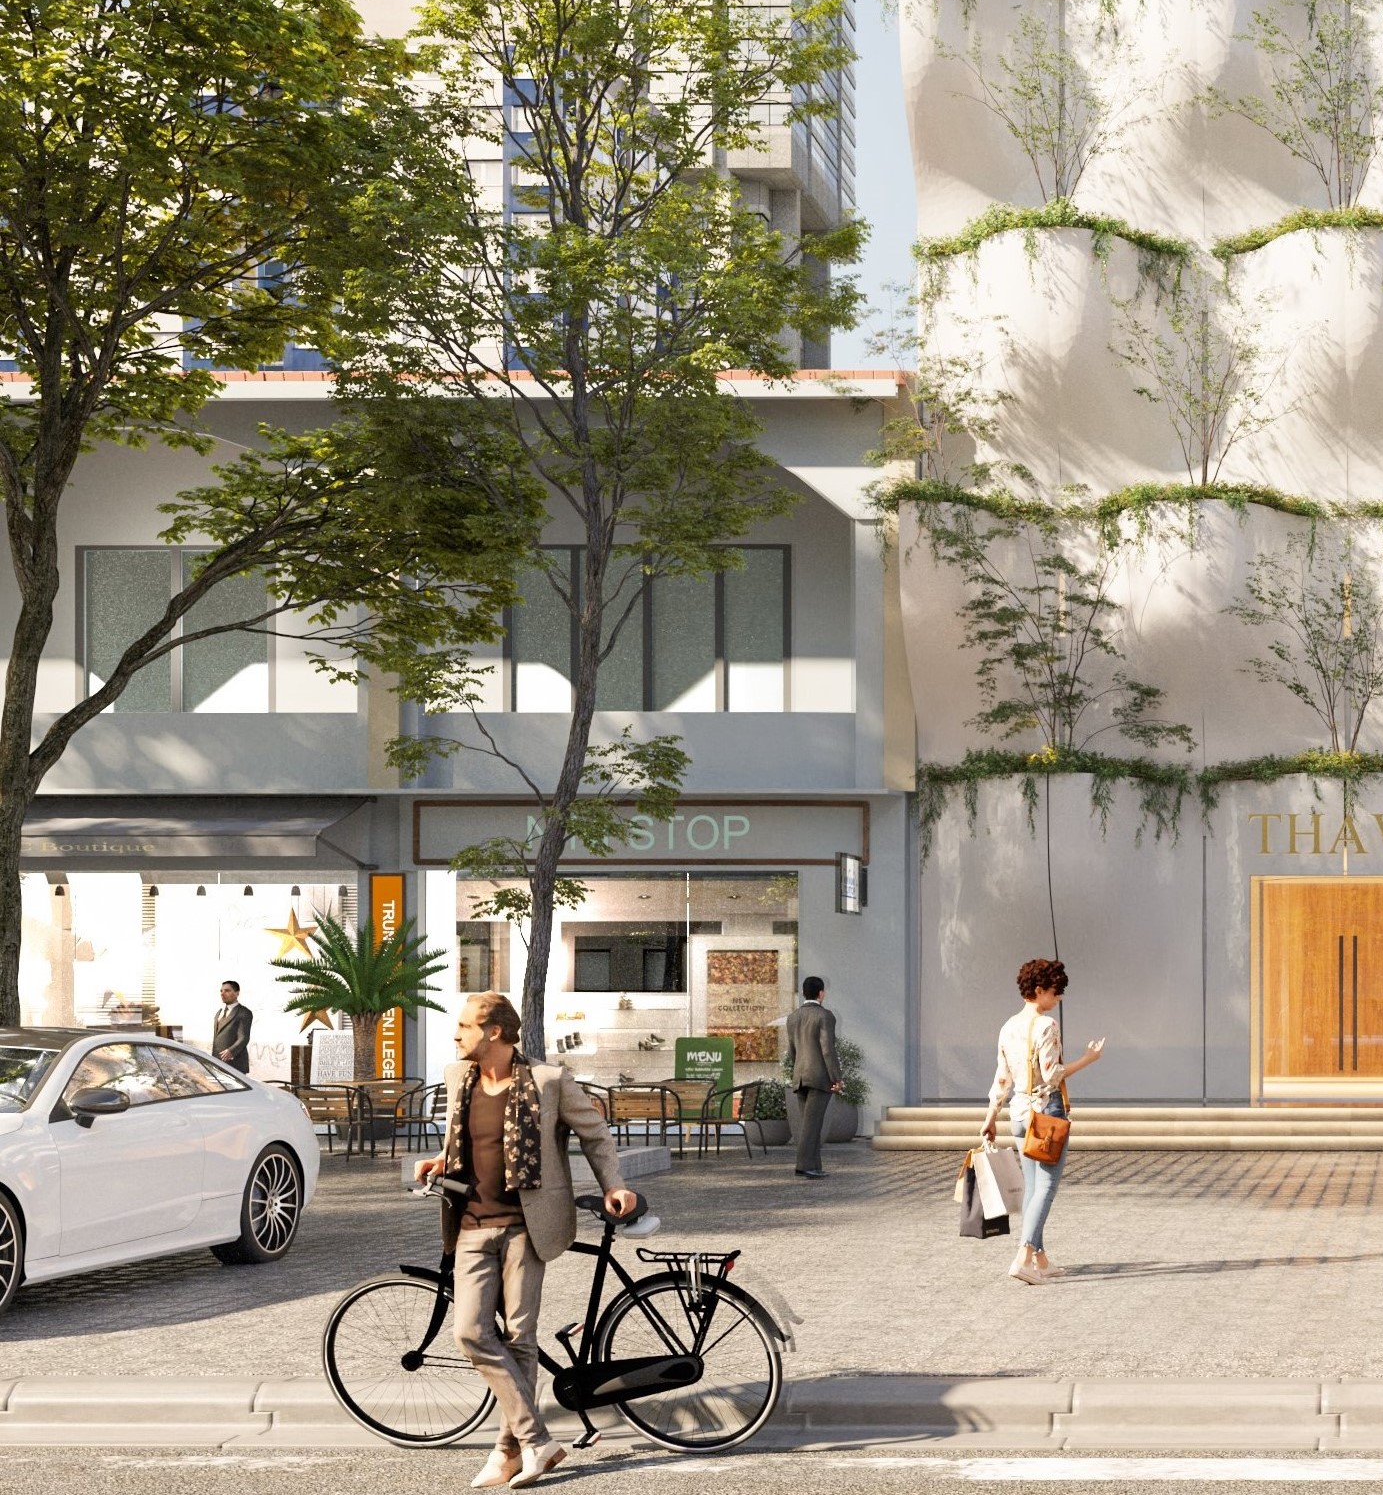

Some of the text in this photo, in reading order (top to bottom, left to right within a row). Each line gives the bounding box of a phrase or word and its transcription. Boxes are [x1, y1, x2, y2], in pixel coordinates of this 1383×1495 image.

[629, 814, 751, 851] STOP
[40, 841, 156, 853] Boutique
[382, 899, 396, 945] TRUN
[382, 1040, 396, 1094] LEGE
[686, 1050, 722, 1063] MENU
[317, 1070, 352, 1078] HAVE FUN
